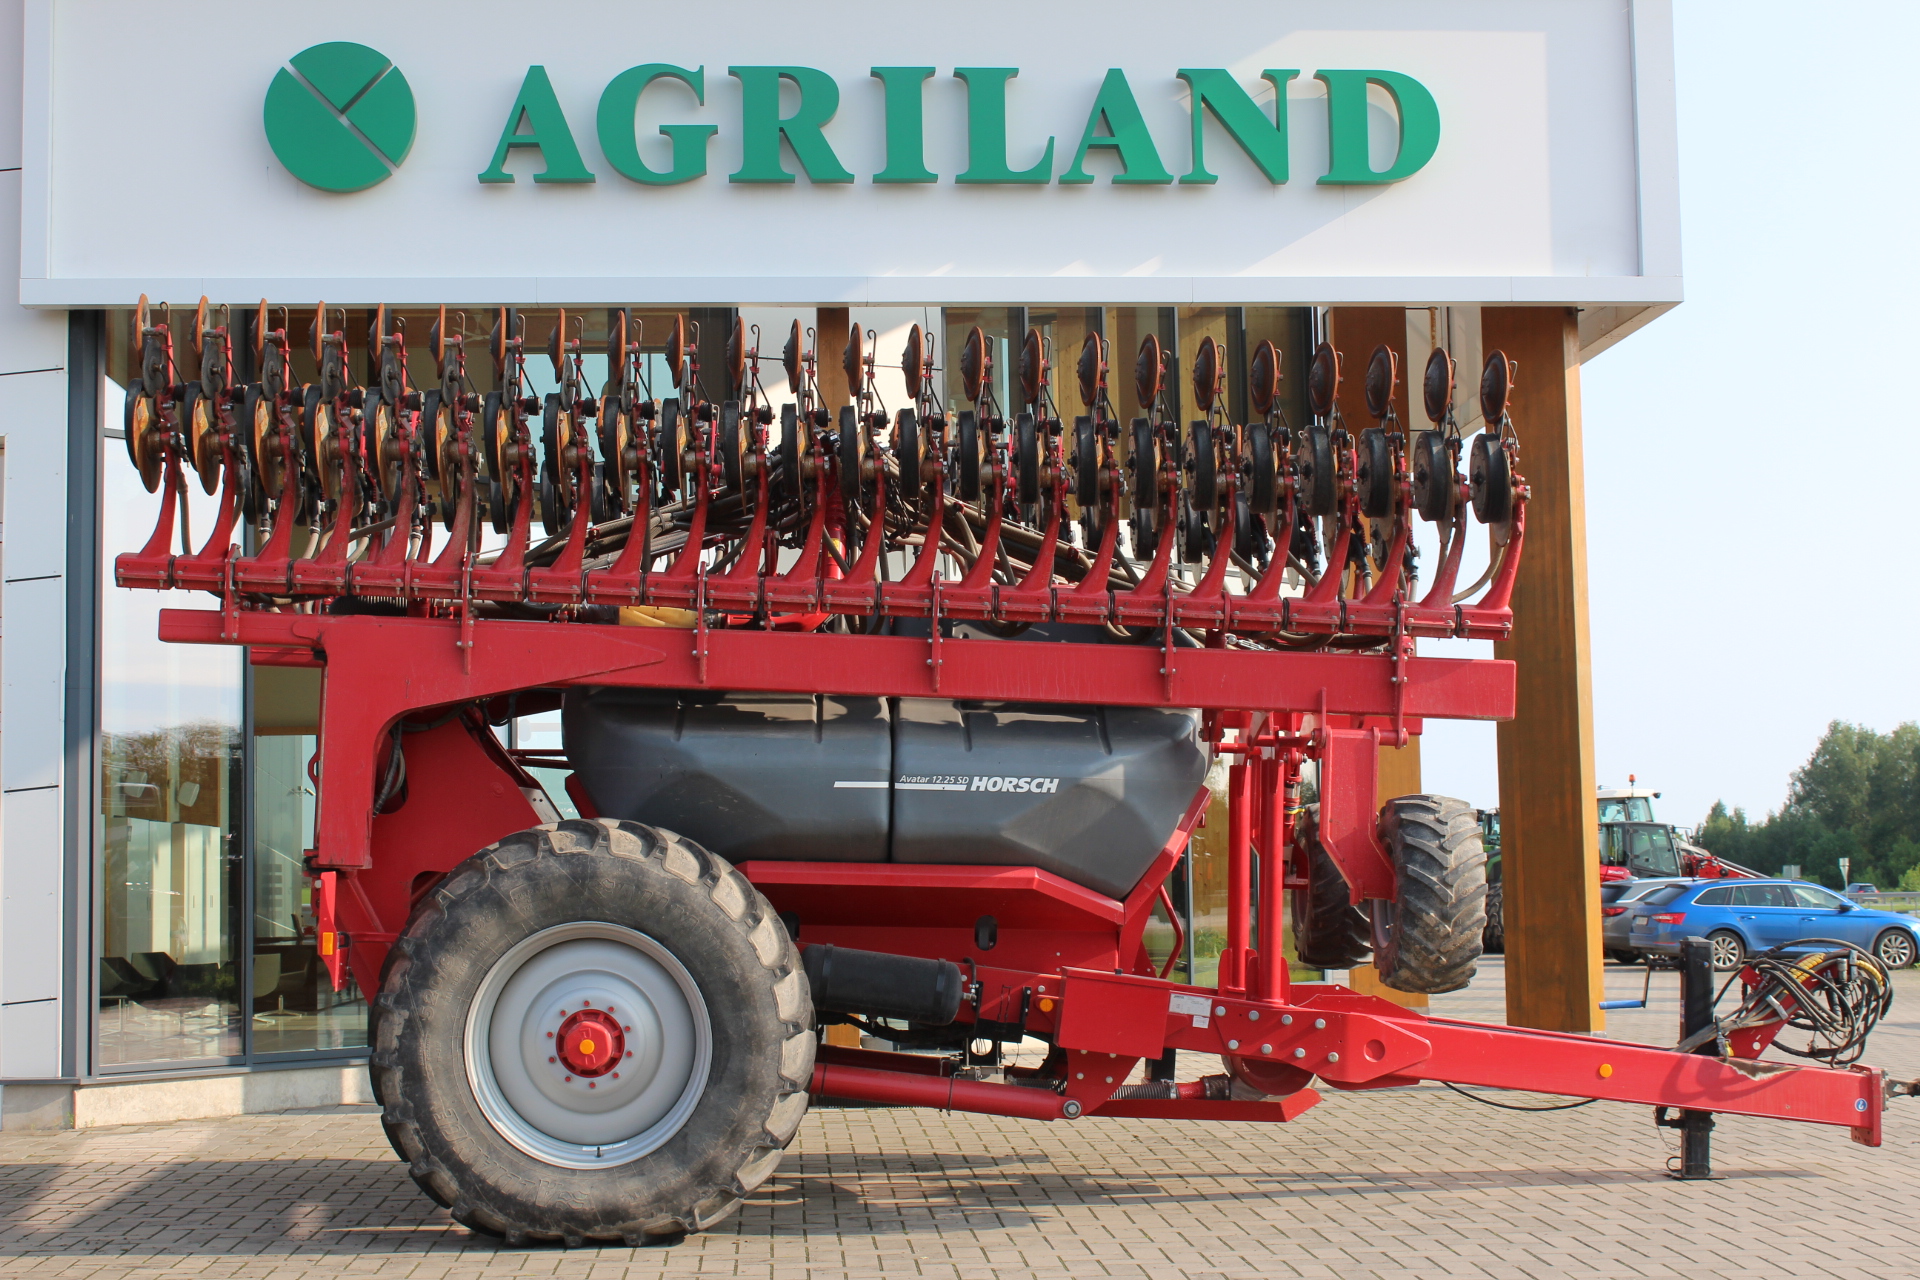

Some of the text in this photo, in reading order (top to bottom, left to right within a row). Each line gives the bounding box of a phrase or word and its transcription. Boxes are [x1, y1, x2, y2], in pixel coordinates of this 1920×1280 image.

[477, 63, 1441, 186] AGRILAND
[900, 775, 969, 785] Avatar 12.25 SD
[970, 776, 1059, 794] HORSCH
[434, 1108, 563, 1208] ALLIANCE
